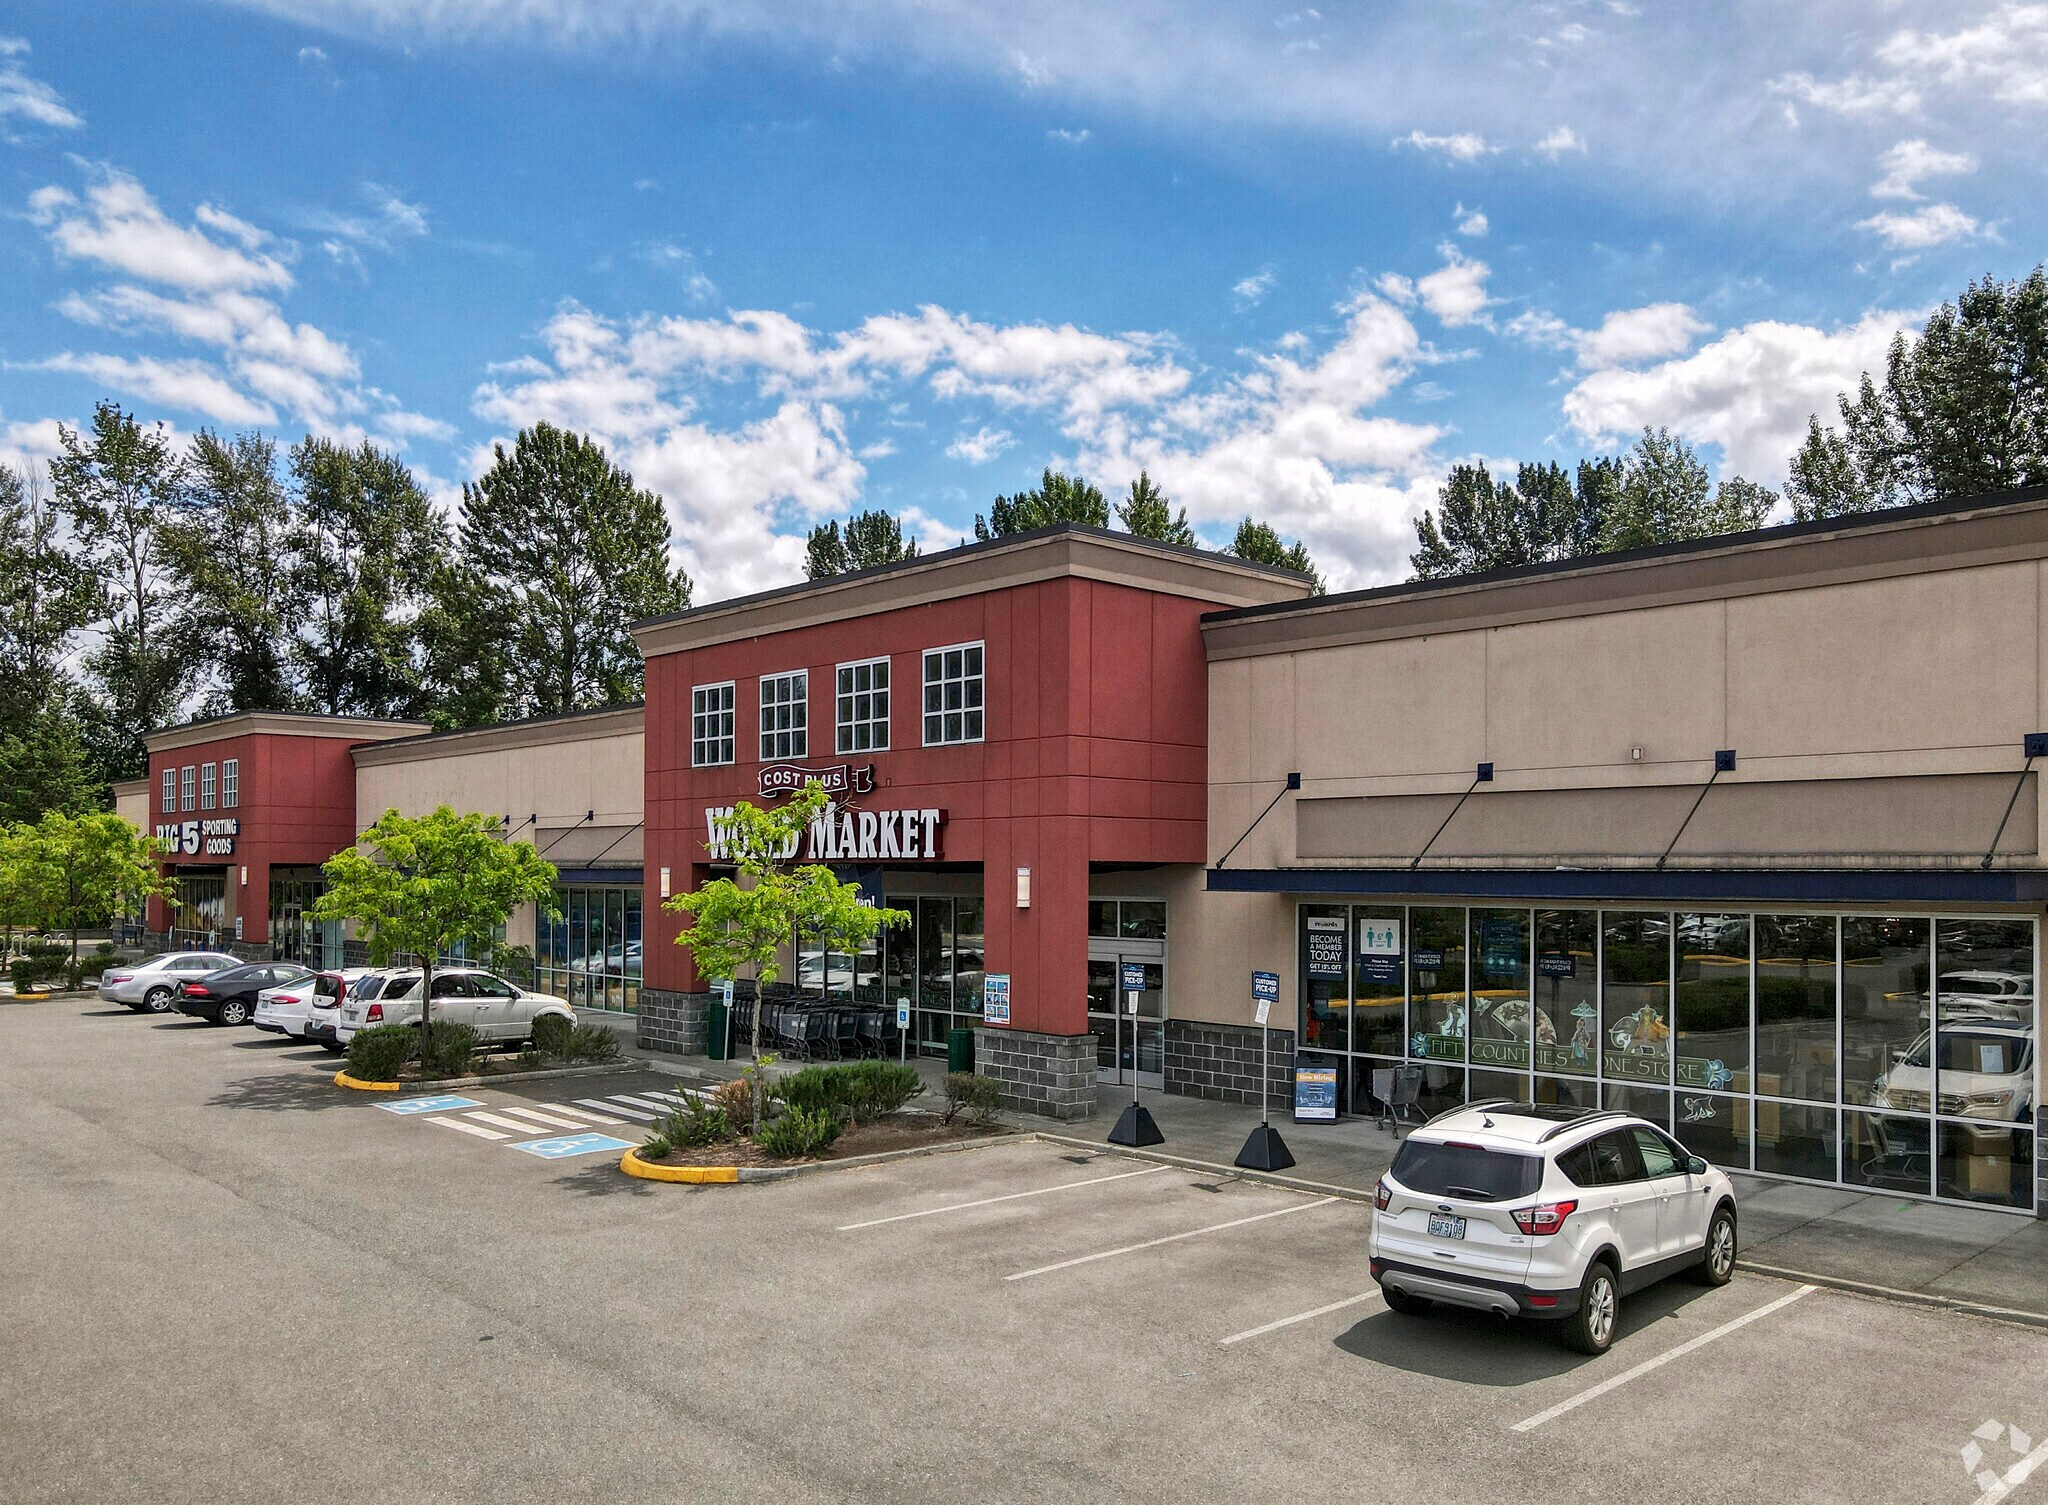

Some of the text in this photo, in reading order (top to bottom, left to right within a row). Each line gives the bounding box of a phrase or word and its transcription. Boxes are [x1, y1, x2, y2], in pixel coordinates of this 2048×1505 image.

[763, 771, 842, 788] COST PUS
[202, 818, 237, 836] SPORTING
[808, 801, 940, 859] MARKET
[182, 821, 200, 854] 5
[206, 838, 232, 855] GOODS
[1309, 934, 1343, 945] BECOME
[1316, 943, 1343, 951] MEMBER
[1310, 950, 1343, 962] TODAY
[1255, 984, 1277, 994] PICK-UP
[1432, 1039, 1464, 1055] FIFT
